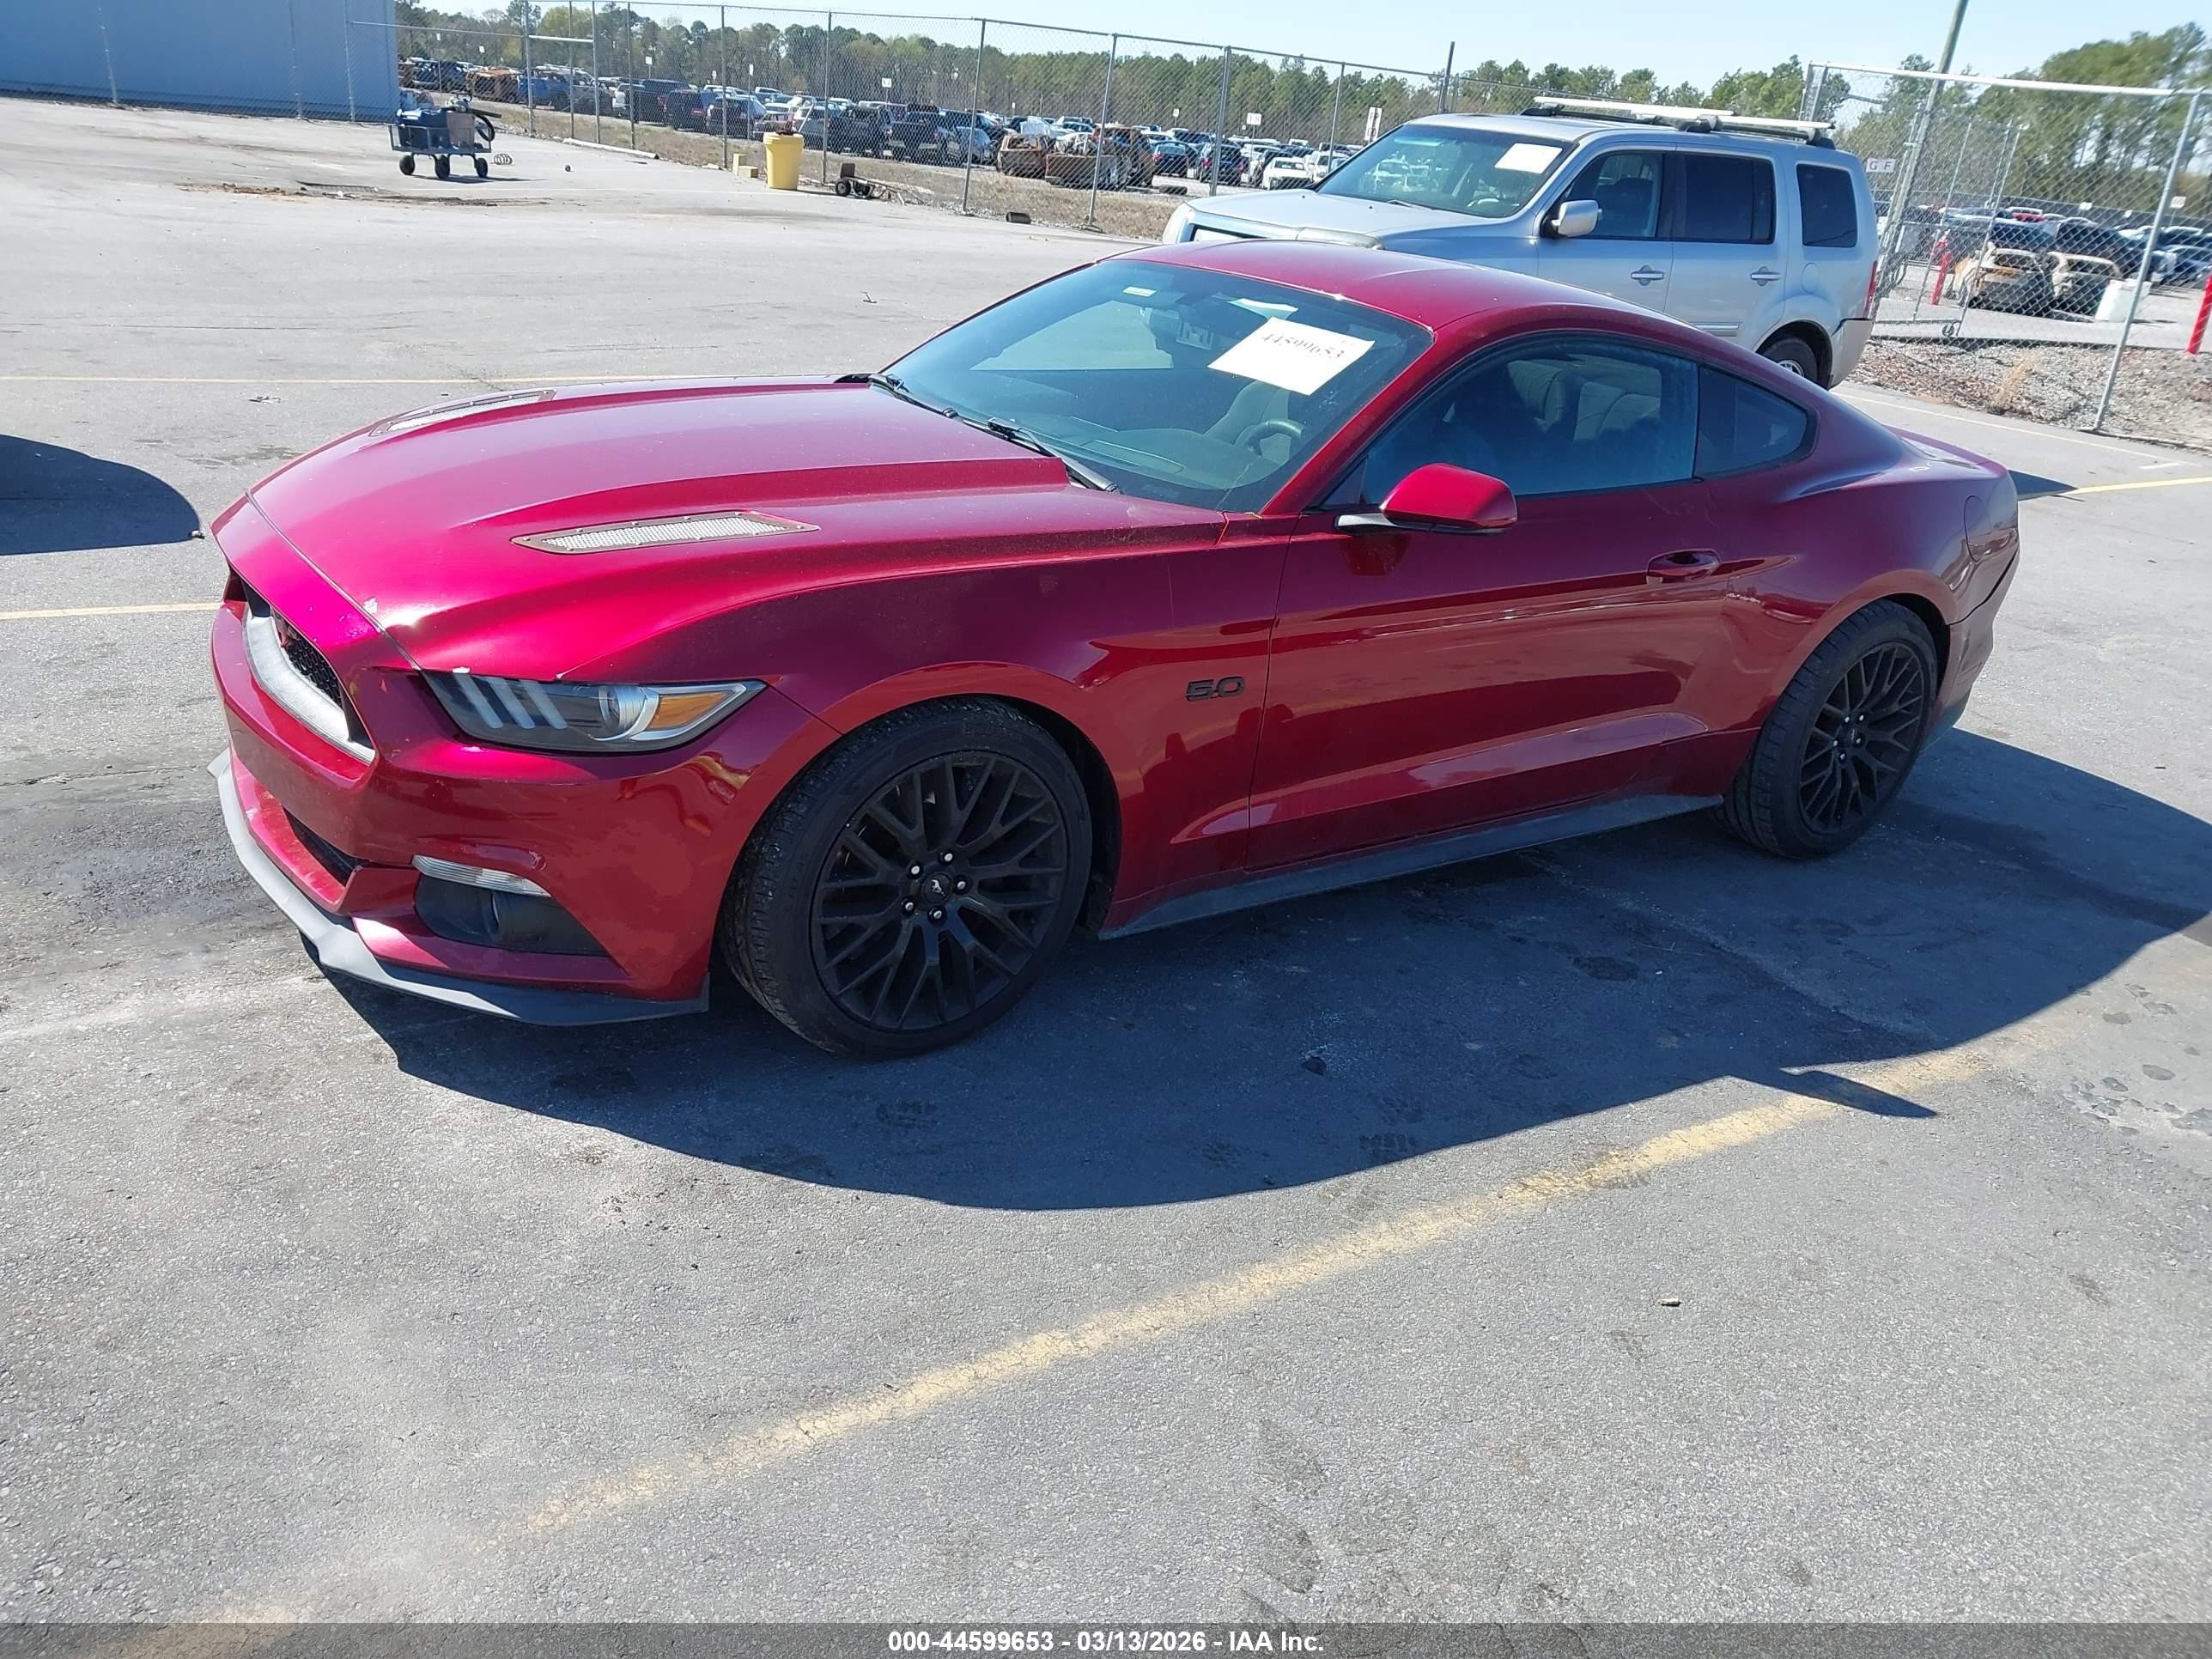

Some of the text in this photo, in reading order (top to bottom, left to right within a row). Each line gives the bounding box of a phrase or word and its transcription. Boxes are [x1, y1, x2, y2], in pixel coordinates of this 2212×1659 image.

[1869, 161, 1892, 171] G F
[1186, 675, 1245, 702] 5.0
